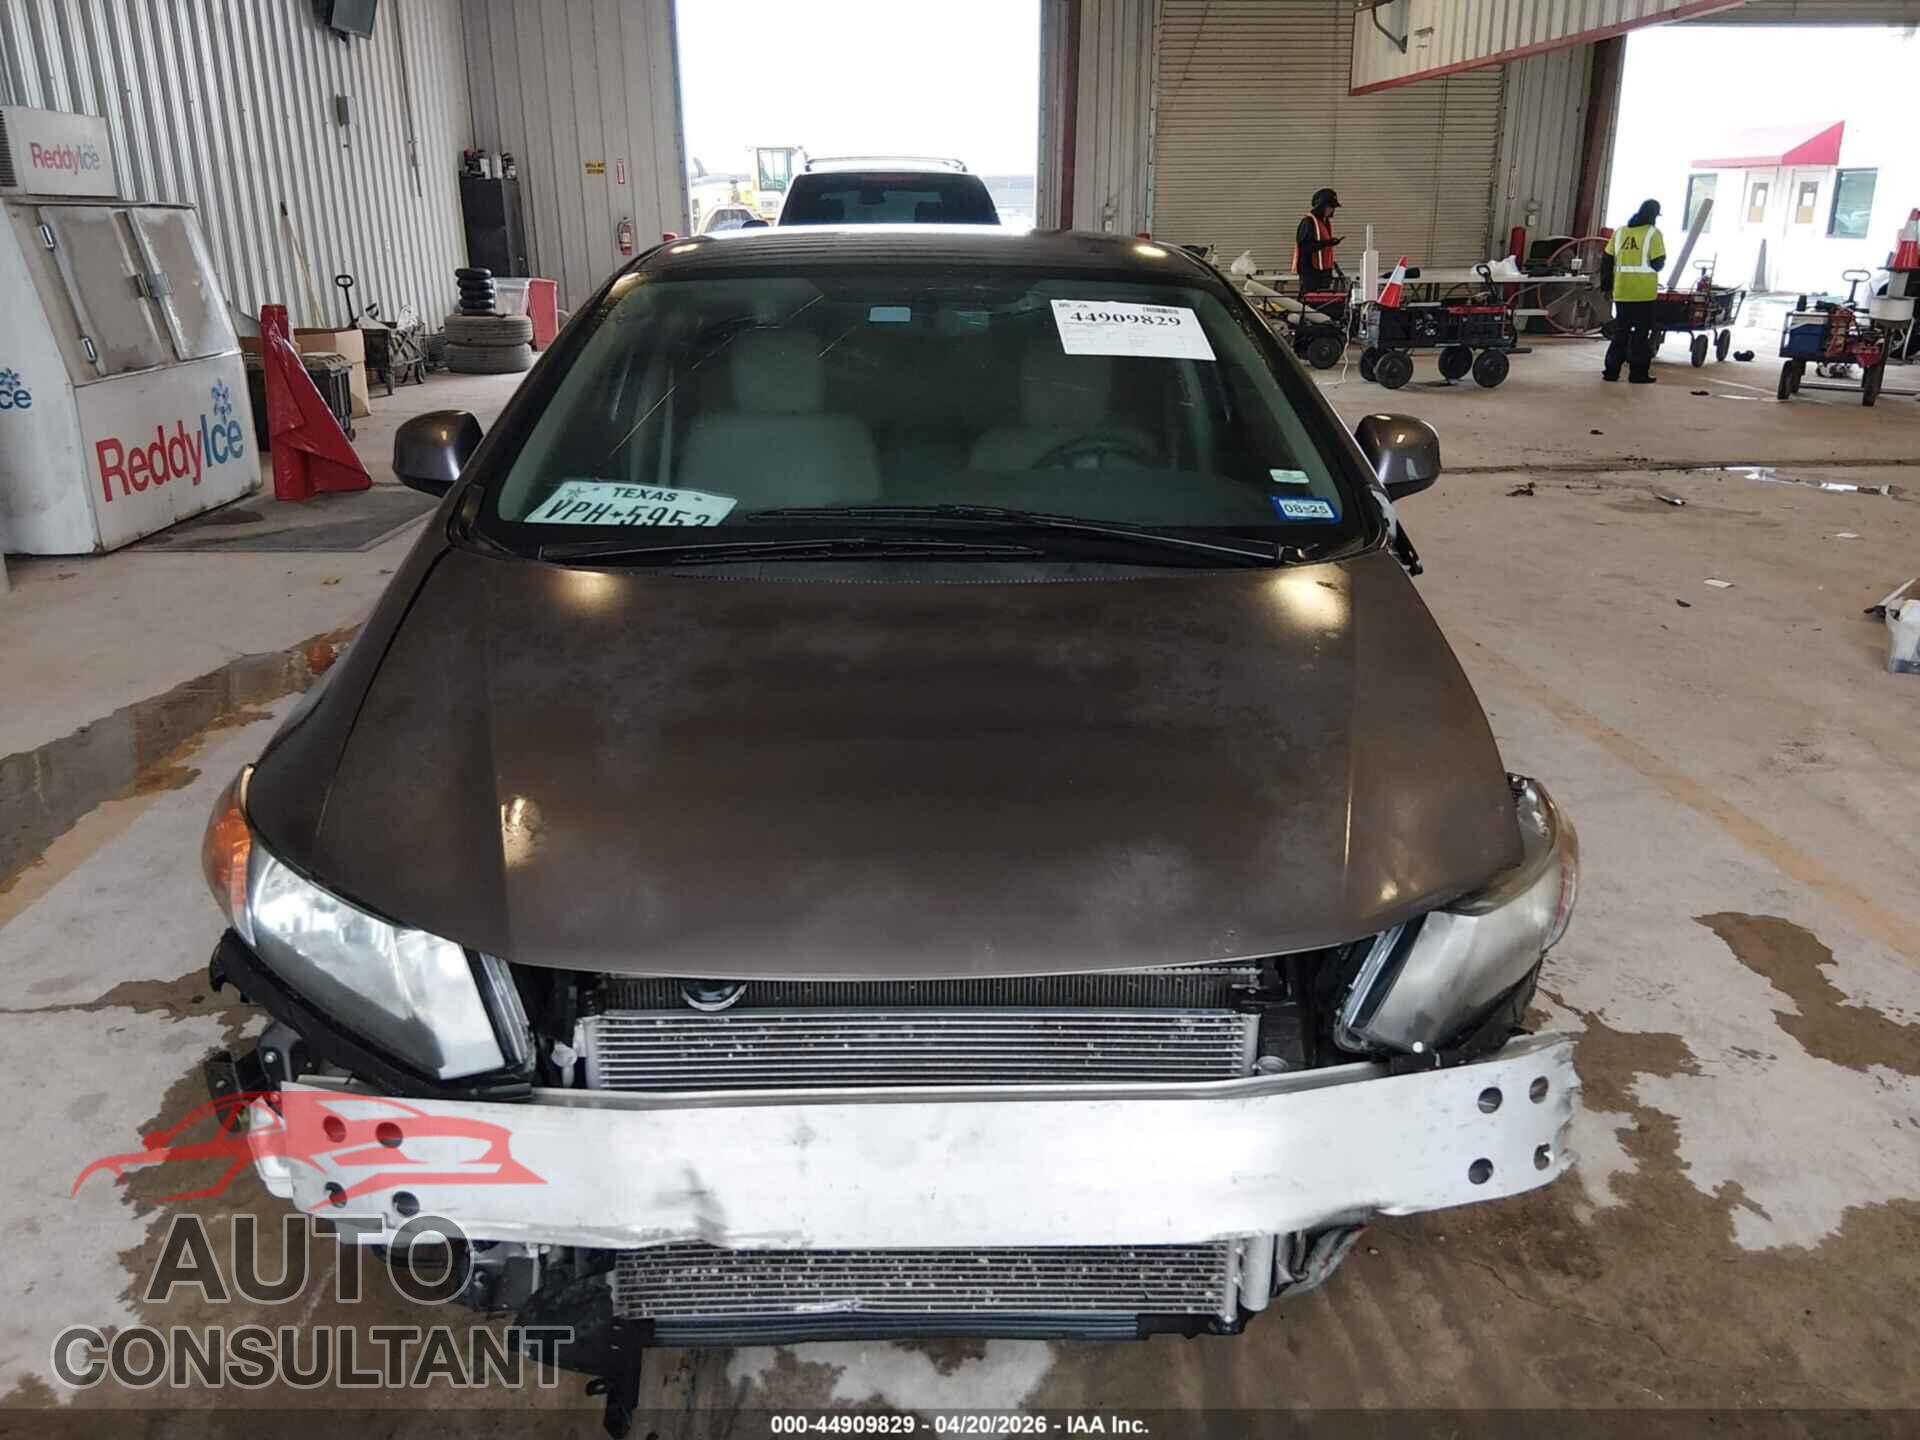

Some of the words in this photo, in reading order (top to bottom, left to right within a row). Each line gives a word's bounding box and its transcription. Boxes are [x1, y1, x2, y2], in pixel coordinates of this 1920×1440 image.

[1070, 311, 1182, 327] 44909829
[95, 414, 244, 502] ReddyIce
[613, 486, 678, 502] TEXAS
